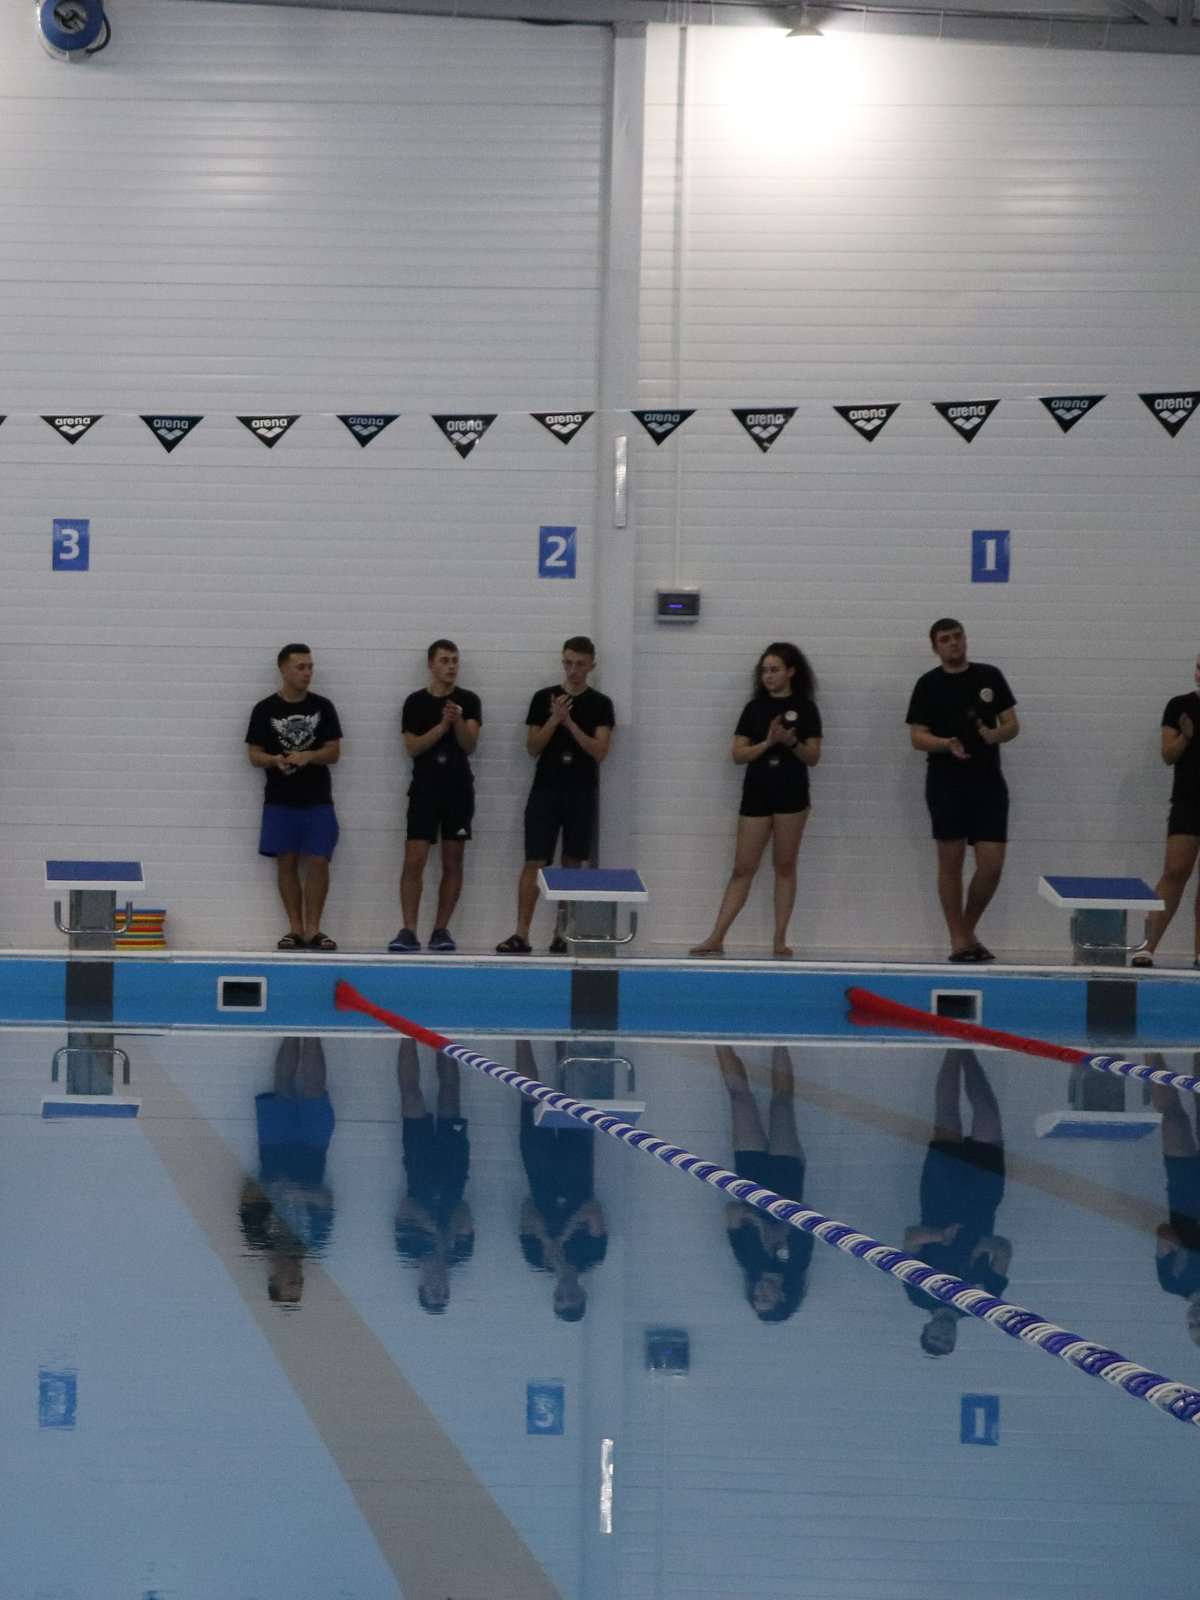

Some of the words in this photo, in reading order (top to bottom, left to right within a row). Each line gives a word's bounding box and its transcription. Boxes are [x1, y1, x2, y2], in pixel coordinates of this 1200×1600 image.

[1051, 399, 1089, 409] arena
[1155, 397, 1192, 409] arena
[644, 411, 680, 422] arena
[849, 408, 887, 420] arena
[949, 405, 986, 417] arena
[55, 417, 91, 426] arena
[154, 418, 189, 429] arena
[252, 417, 288, 428] arena
[349, 417, 384, 426] arena
[546, 414, 583, 424] arena
[747, 414, 783, 425] arena
[447, 420, 482, 431] arena
[59, 528, 80, 560] 3
[545, 536, 568, 567] 2
[980, 539, 999, 571] 1
